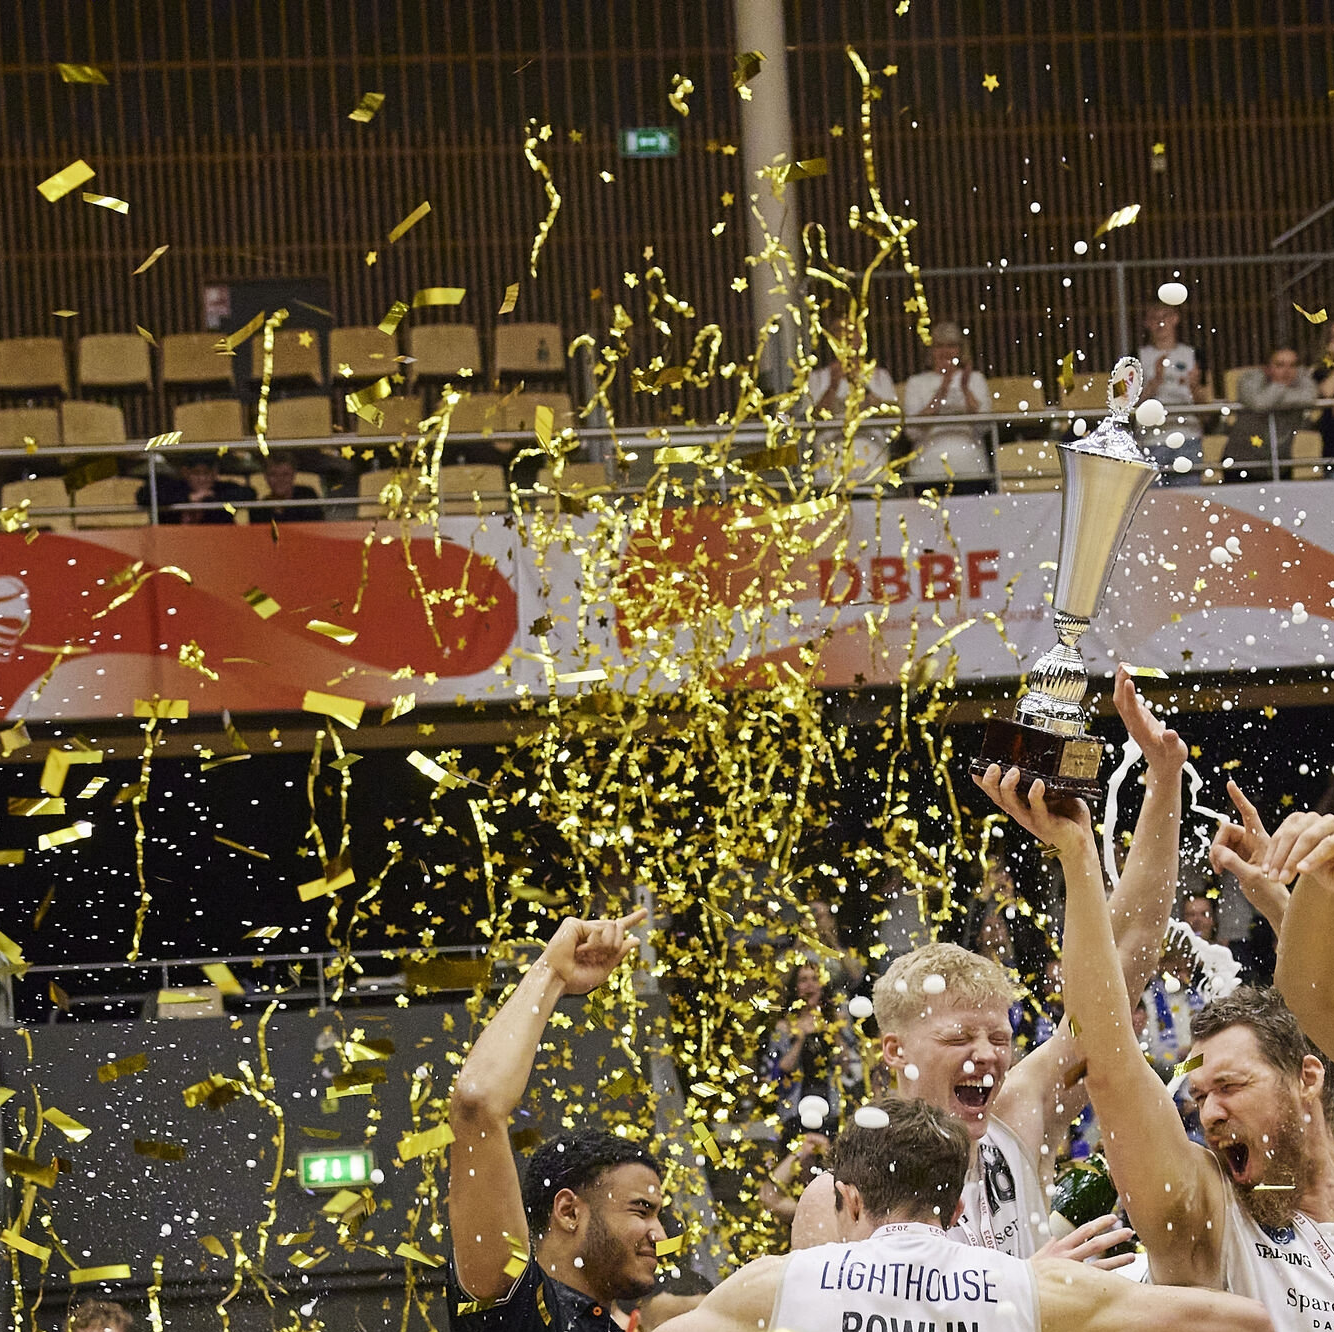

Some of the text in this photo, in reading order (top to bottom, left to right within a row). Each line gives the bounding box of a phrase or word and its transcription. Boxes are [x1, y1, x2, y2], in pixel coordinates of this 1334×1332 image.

[818, 550, 999, 607] DBBF
[820, 1249, 999, 1304] LIGHTHOUSE
[1313, 1239, 1331, 1261] 2023
